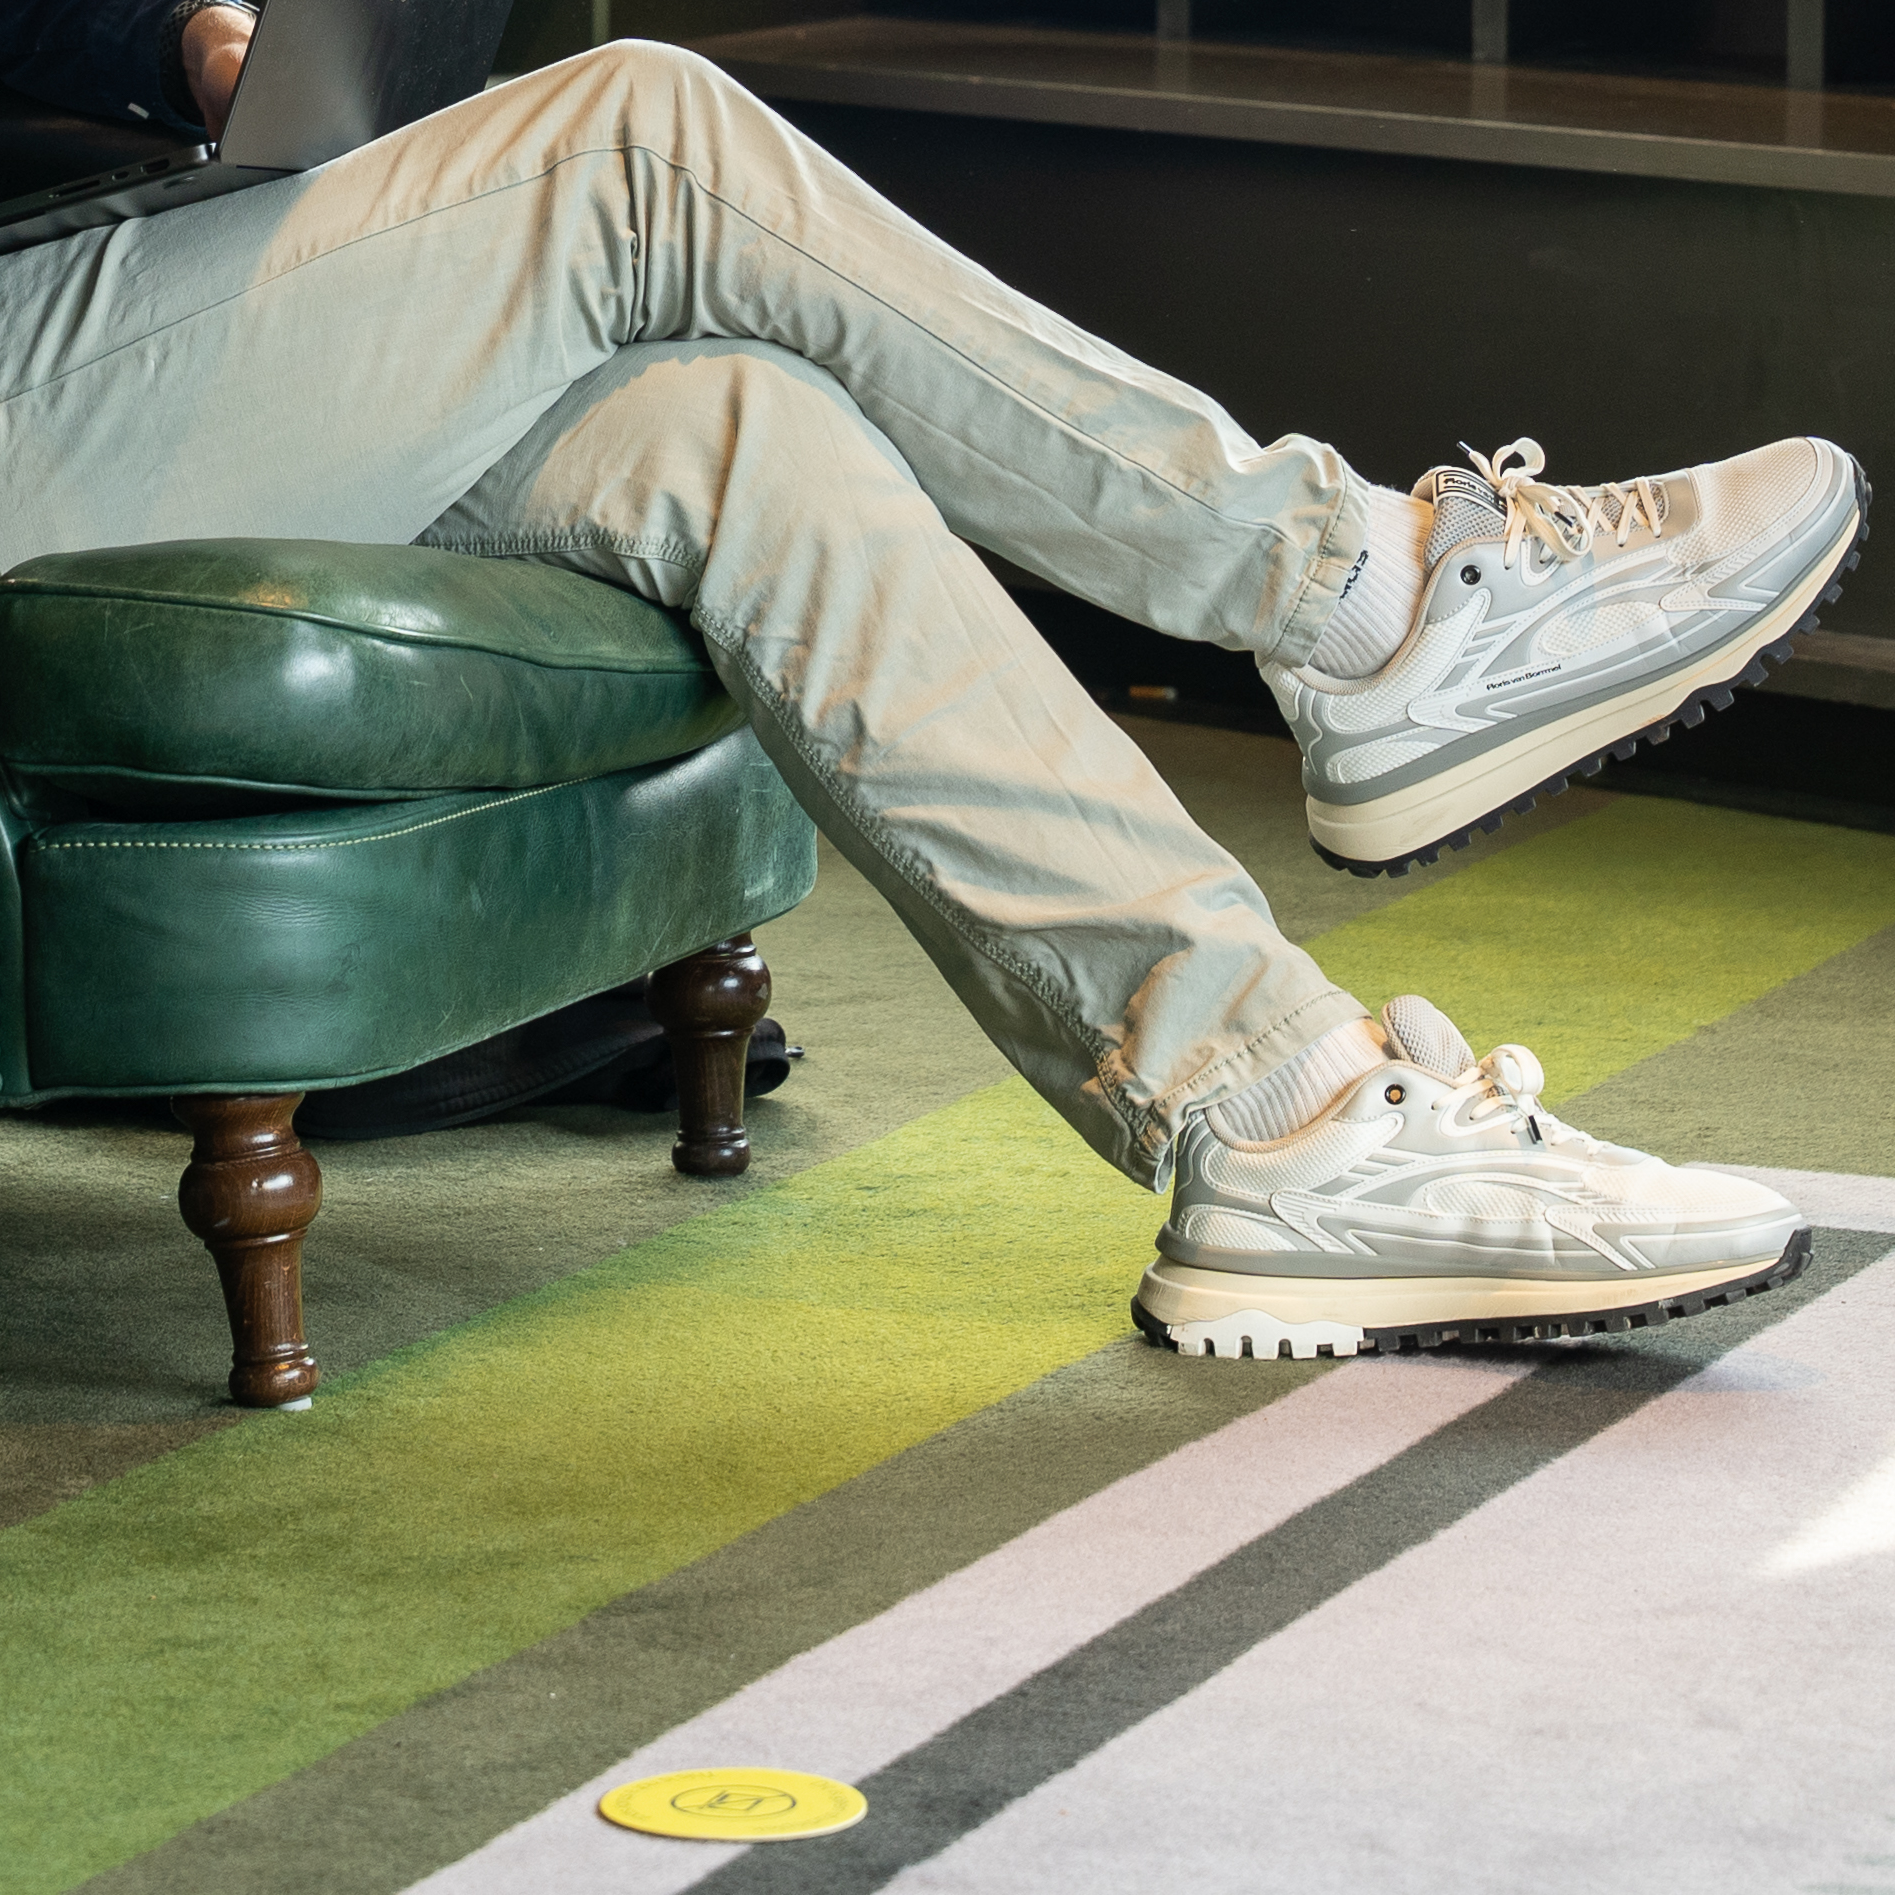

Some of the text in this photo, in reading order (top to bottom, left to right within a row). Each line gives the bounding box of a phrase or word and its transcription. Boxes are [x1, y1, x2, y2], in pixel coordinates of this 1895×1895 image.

[1486, 663, 1562, 691] Floris van Bommel
